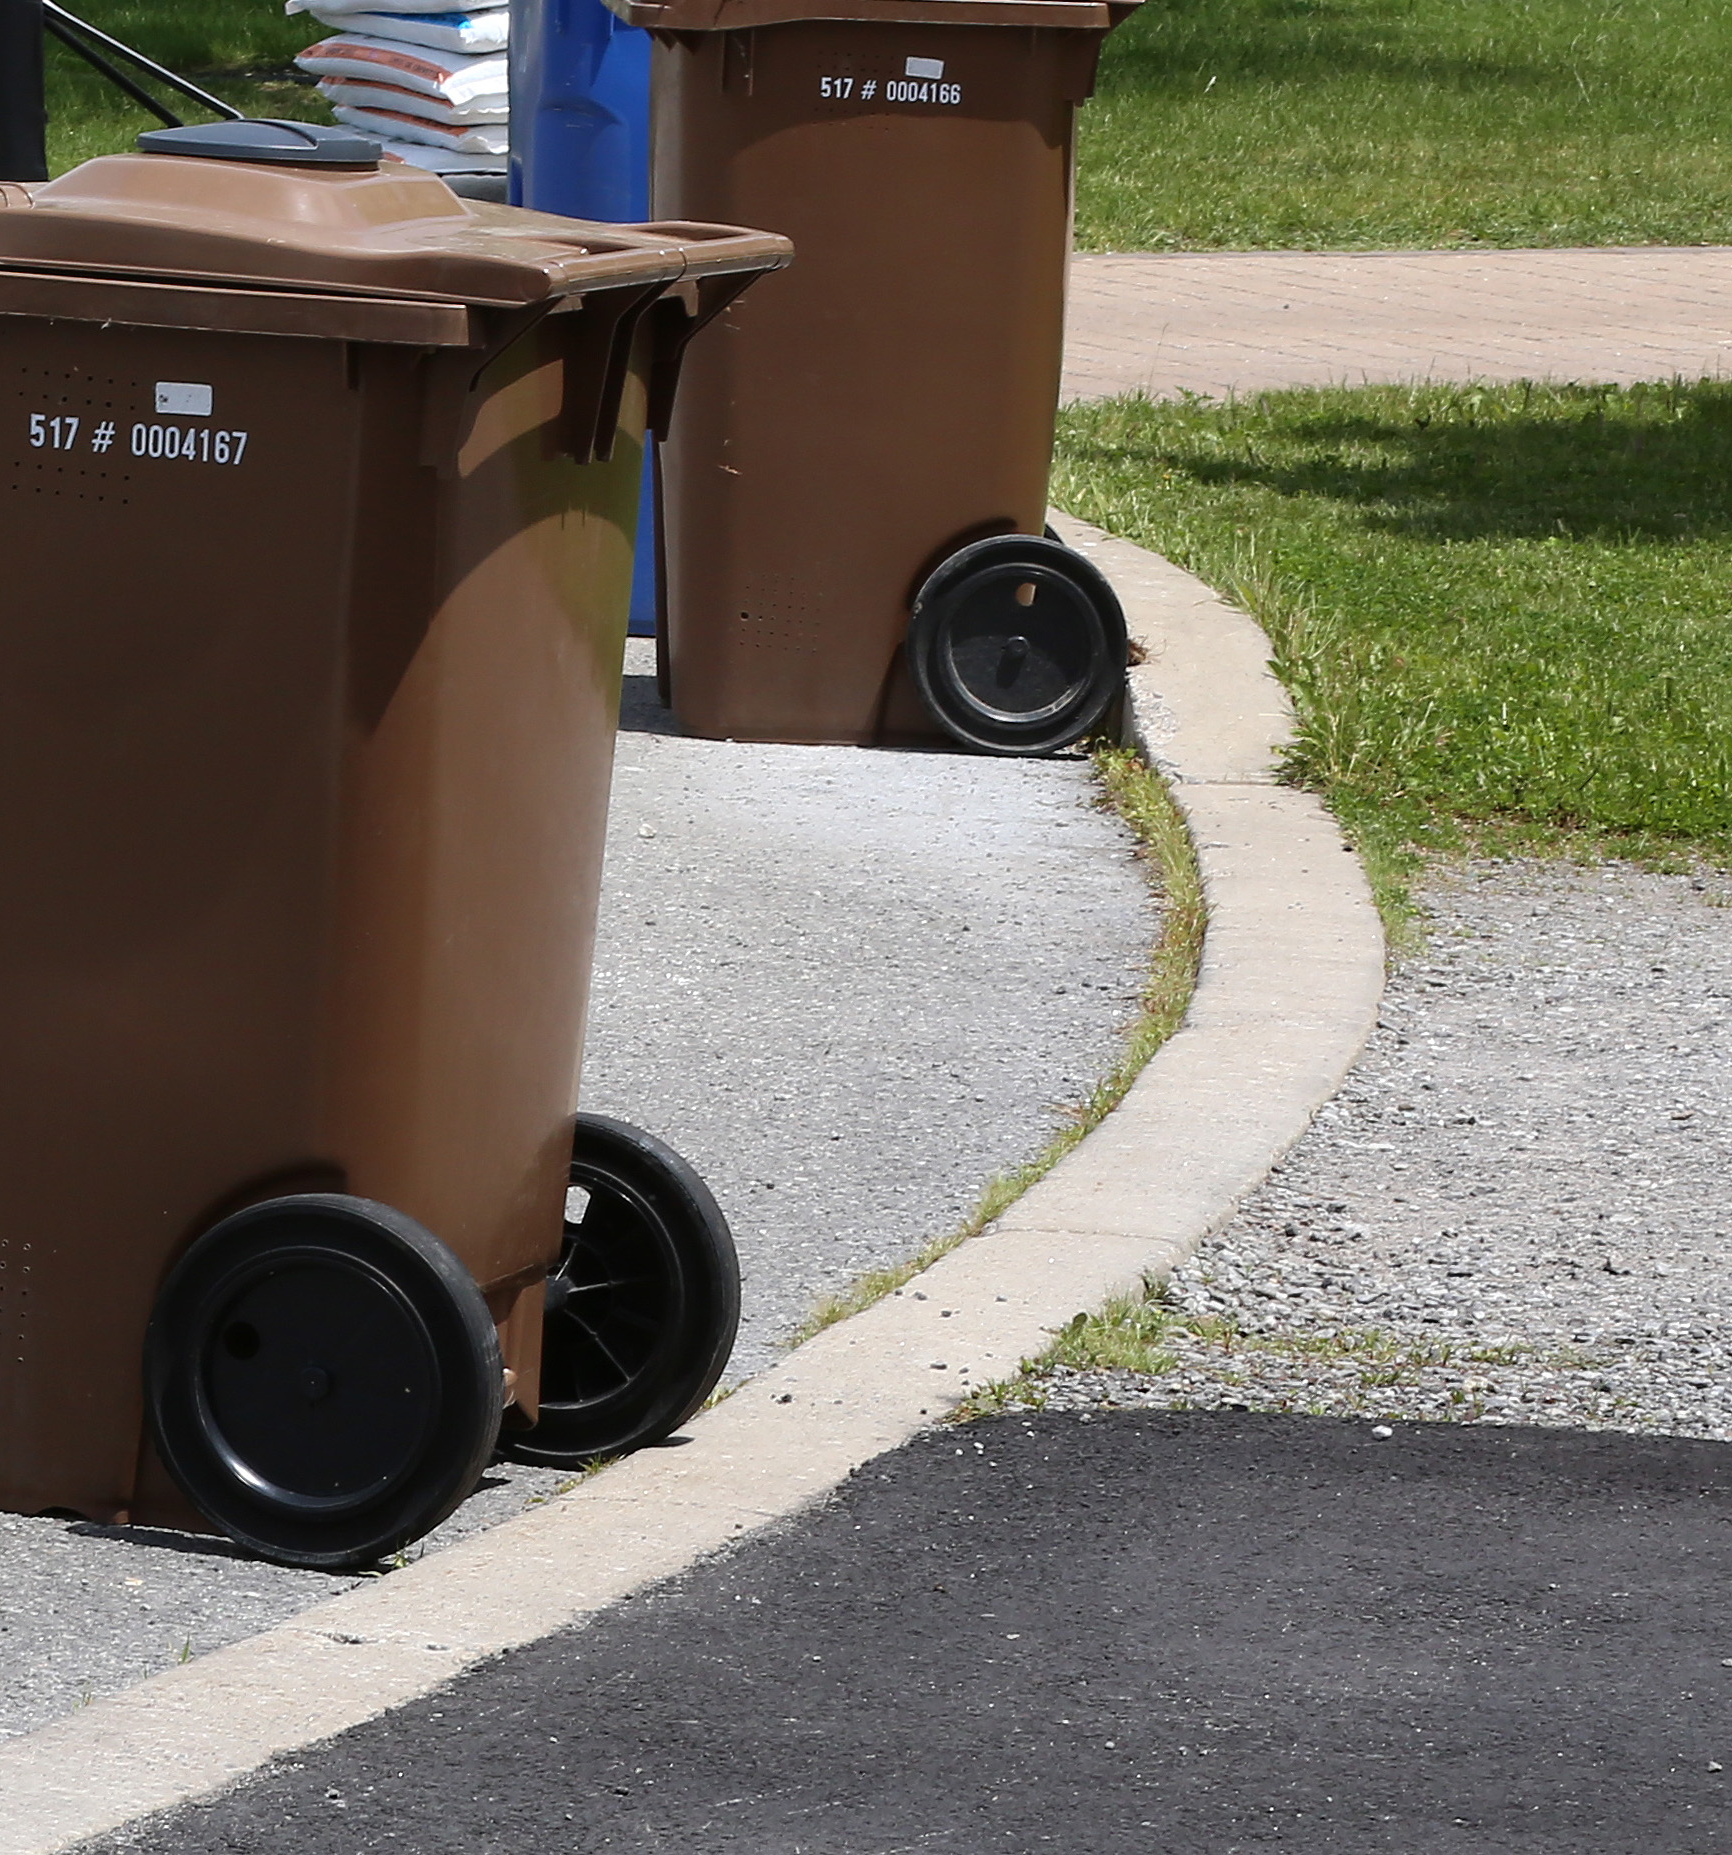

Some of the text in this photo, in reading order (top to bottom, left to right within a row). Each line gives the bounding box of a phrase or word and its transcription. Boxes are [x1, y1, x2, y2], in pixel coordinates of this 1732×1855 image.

[820, 77, 961, 104] 517 # 0004166
[29, 412, 248, 465] 517 # 0004167
